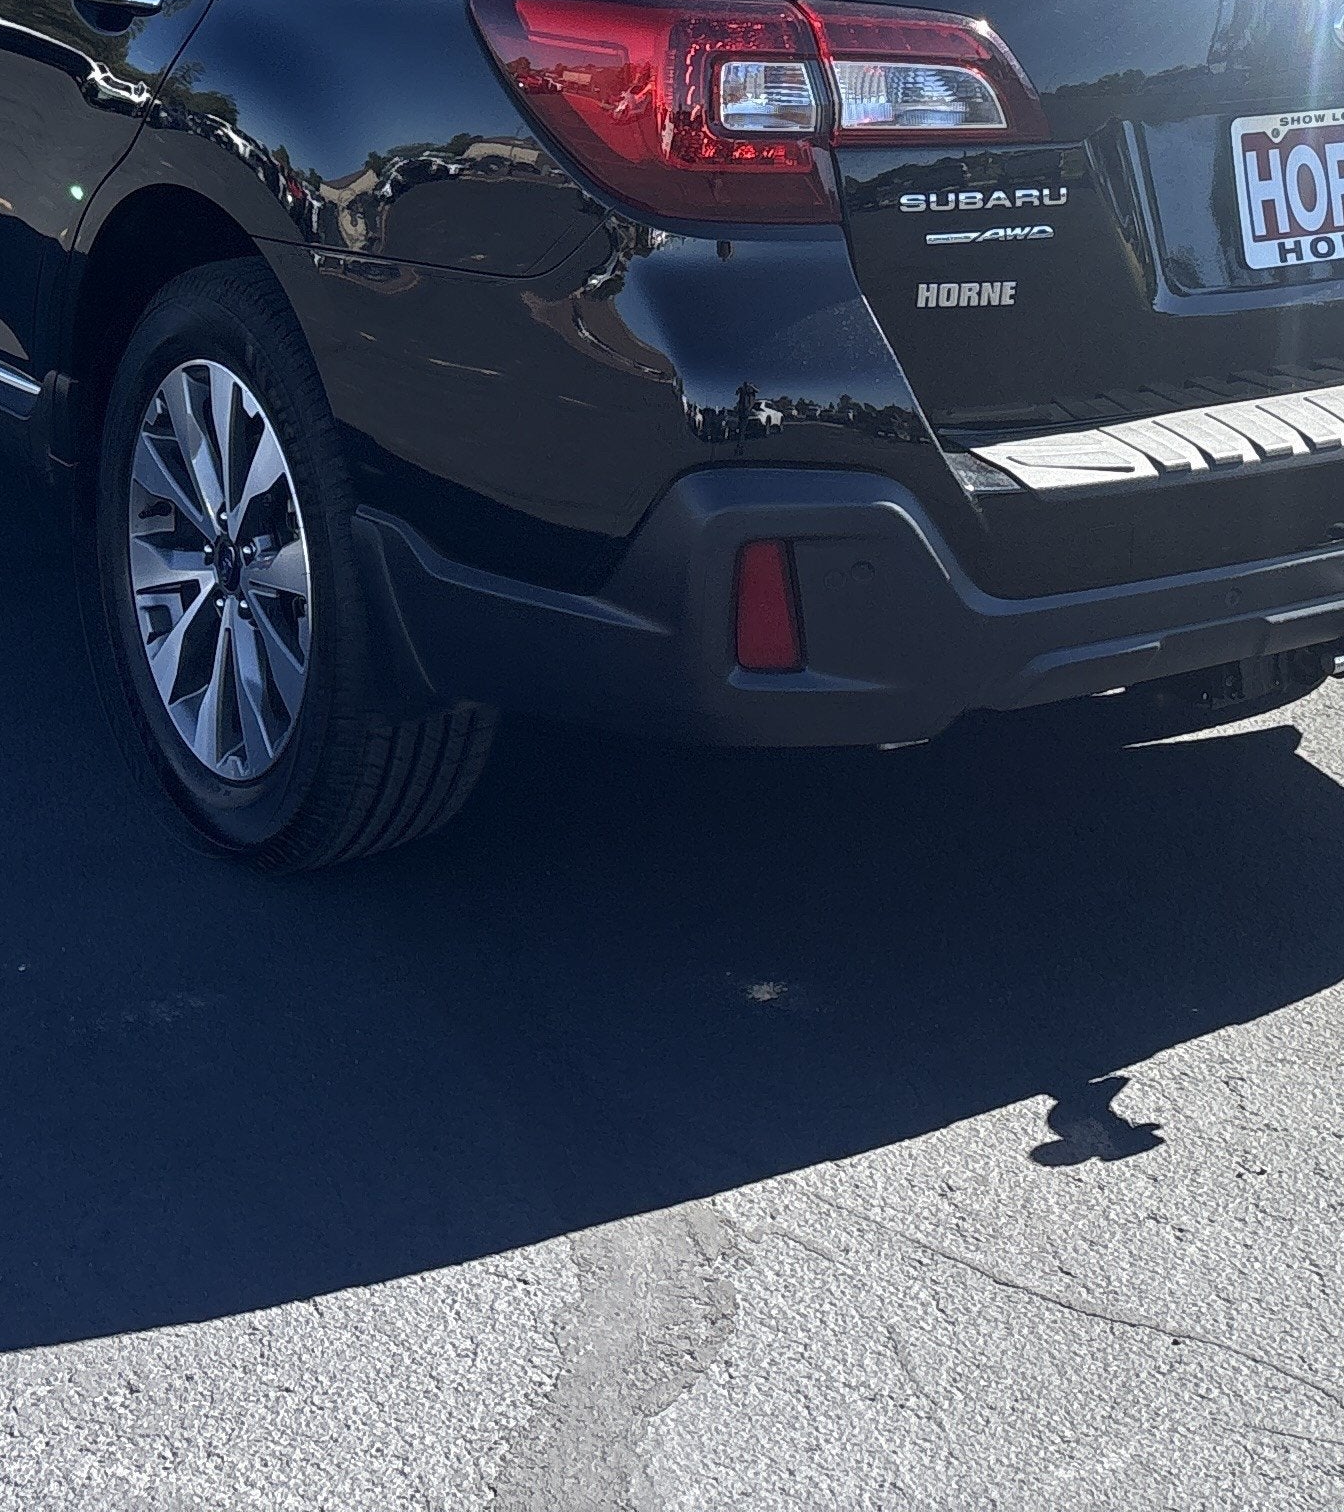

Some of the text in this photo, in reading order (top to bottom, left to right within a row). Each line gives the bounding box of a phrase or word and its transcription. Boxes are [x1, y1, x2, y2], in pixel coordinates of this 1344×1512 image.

[1279, 113, 1326, 127] SHOW
[899, 187, 1068, 213] SUBARU
[975, 225, 1055, 243] AWD
[916, 281, 1017, 308] HORNE
